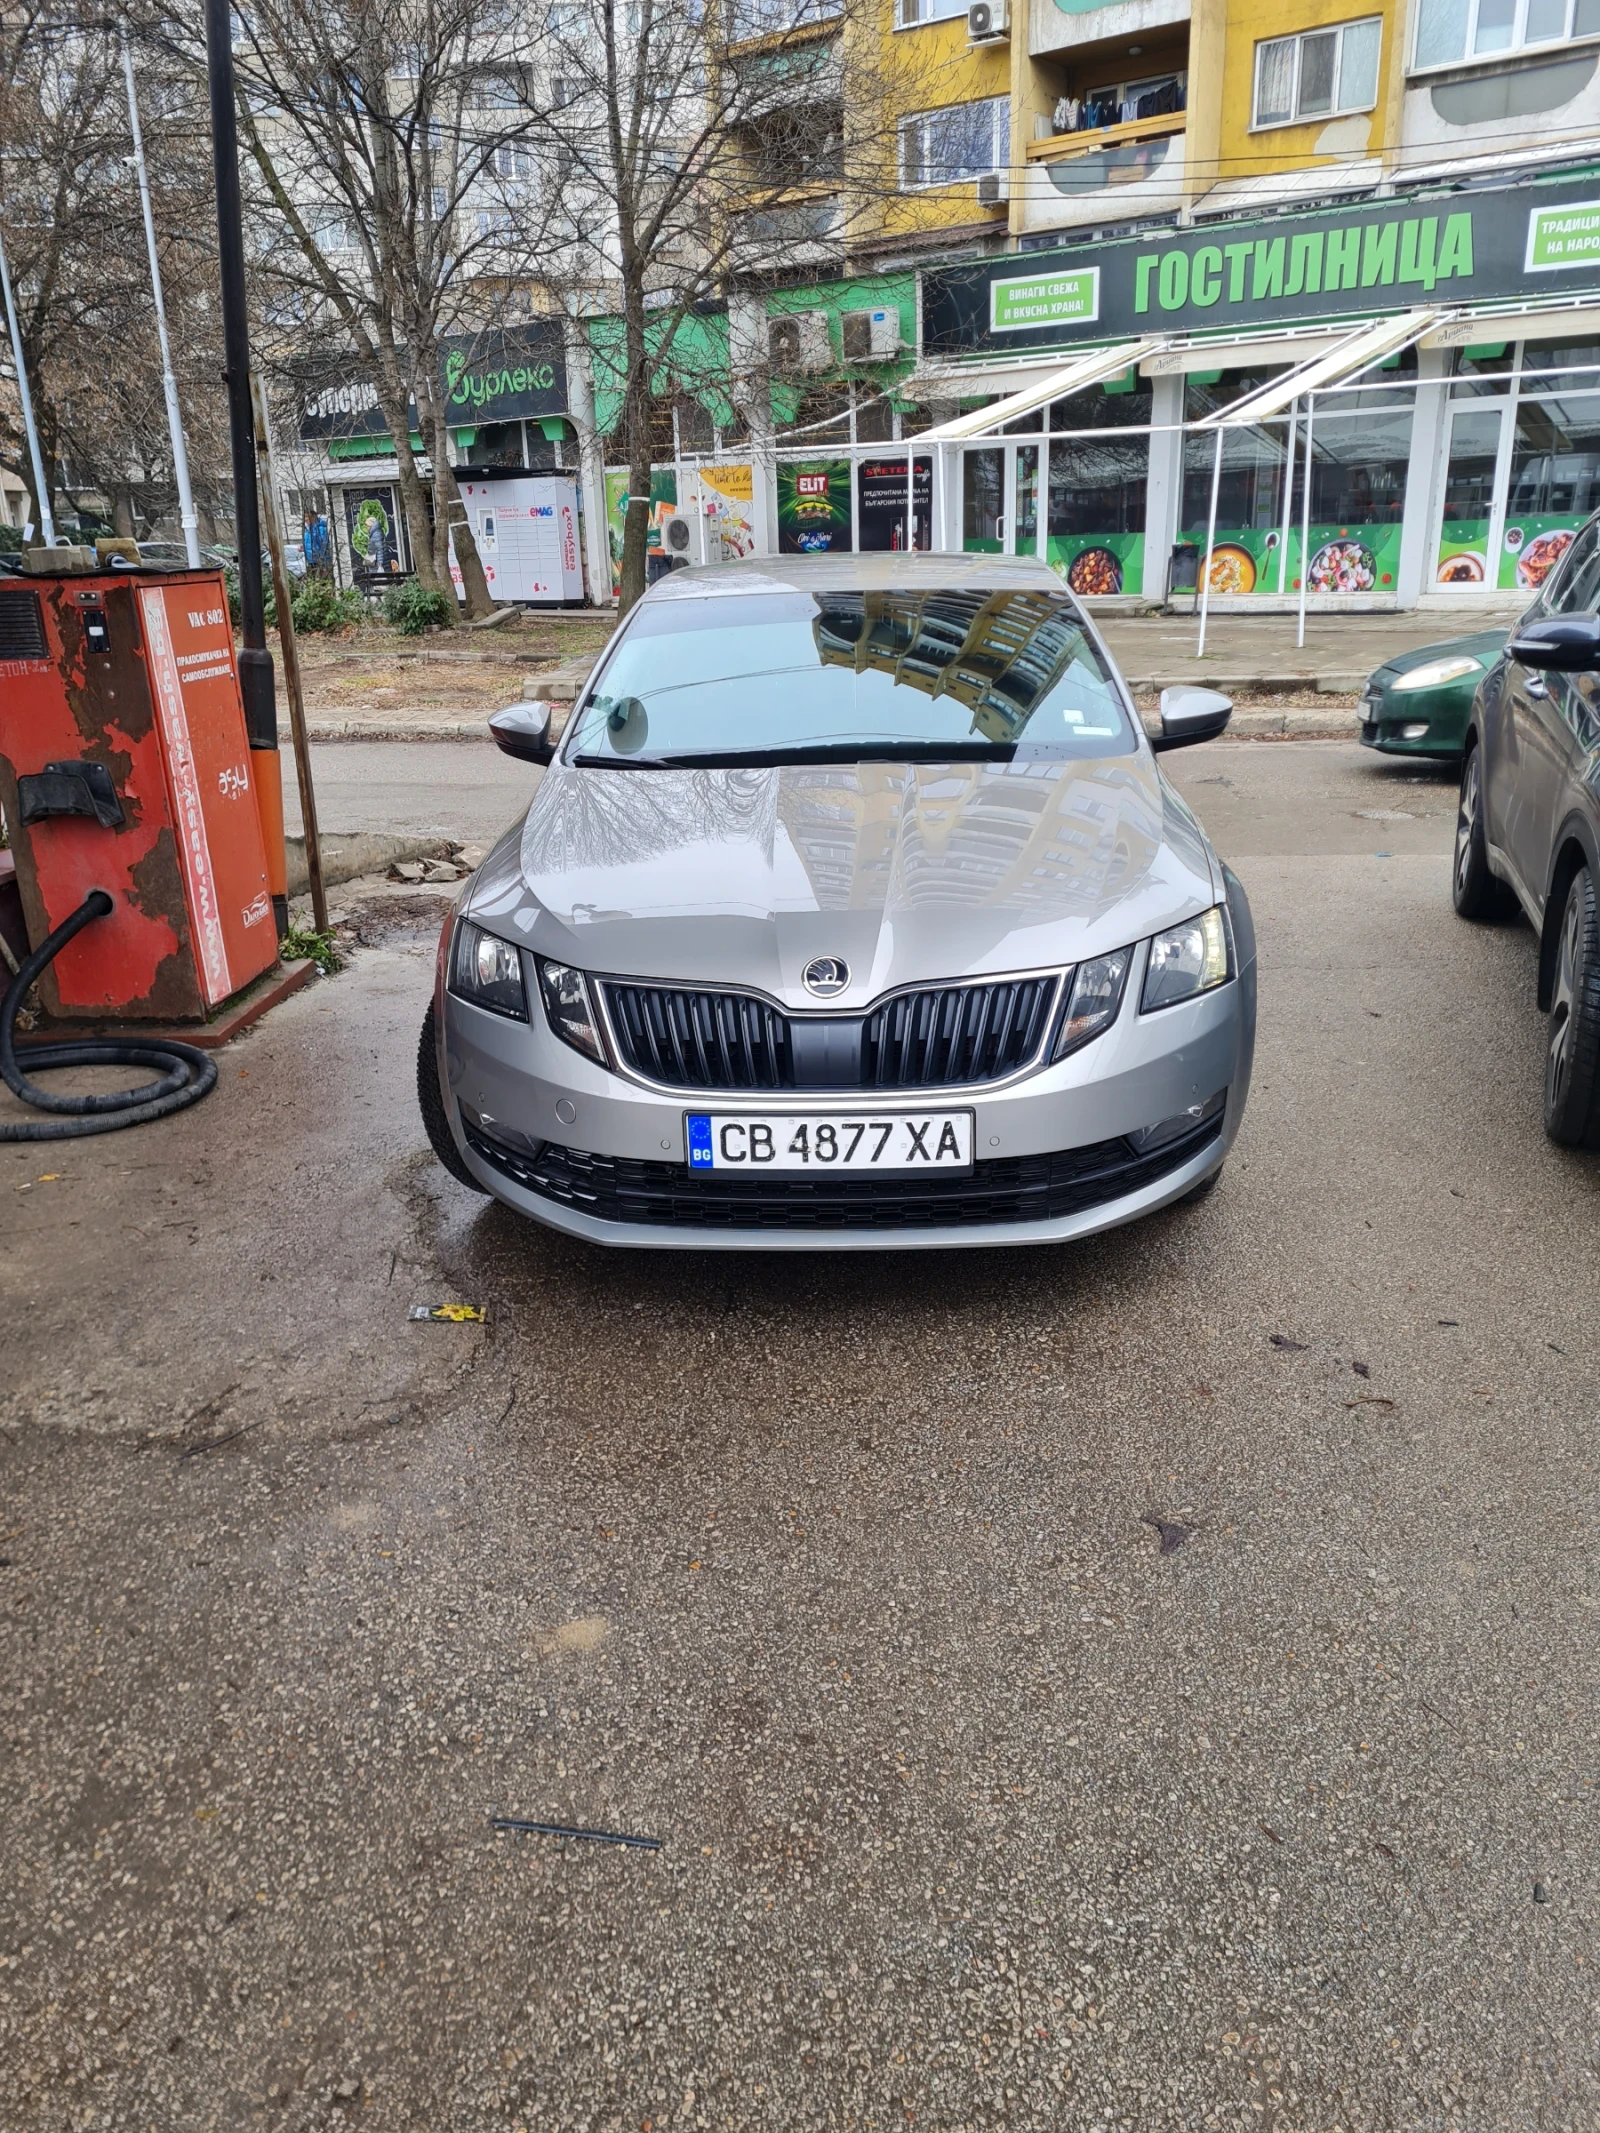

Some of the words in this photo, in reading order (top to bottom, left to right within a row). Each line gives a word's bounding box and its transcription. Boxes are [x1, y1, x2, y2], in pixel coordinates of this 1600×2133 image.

[1547, 241, 1563, 254] НА
[1567, 235, 1600, 252] НАРО
[1135, 212, 1474, 313] ГОСТИЛНИЦА
[1009, 286, 1046, 301] ВИНАГИ
[1048, 281, 1079, 296] СВЕЖА
[1004, 308, 1011, 320] И
[1013, 303, 1049, 318] ВКУСНА
[1051, 299, 1084, 314] ХРАНА!
[530, 506, 553, 517] eMAG
[566, 515, 575, 571] easybox
[187, 611, 206, 628] VAC
[206, 608, 224, 625] 802
[176, 649, 222, 667] ПРАХОСМУКАЧКА
[222, 648, 230, 658] НА
[181, 663, 231, 683] САМООБСЛУЖВАНЕ
[720, 1123, 777, 1163] CB
[787, 1122, 893, 1164] 4877
[905, 1121, 961, 1162] XA
[693, 1148, 711, 1161] BG
